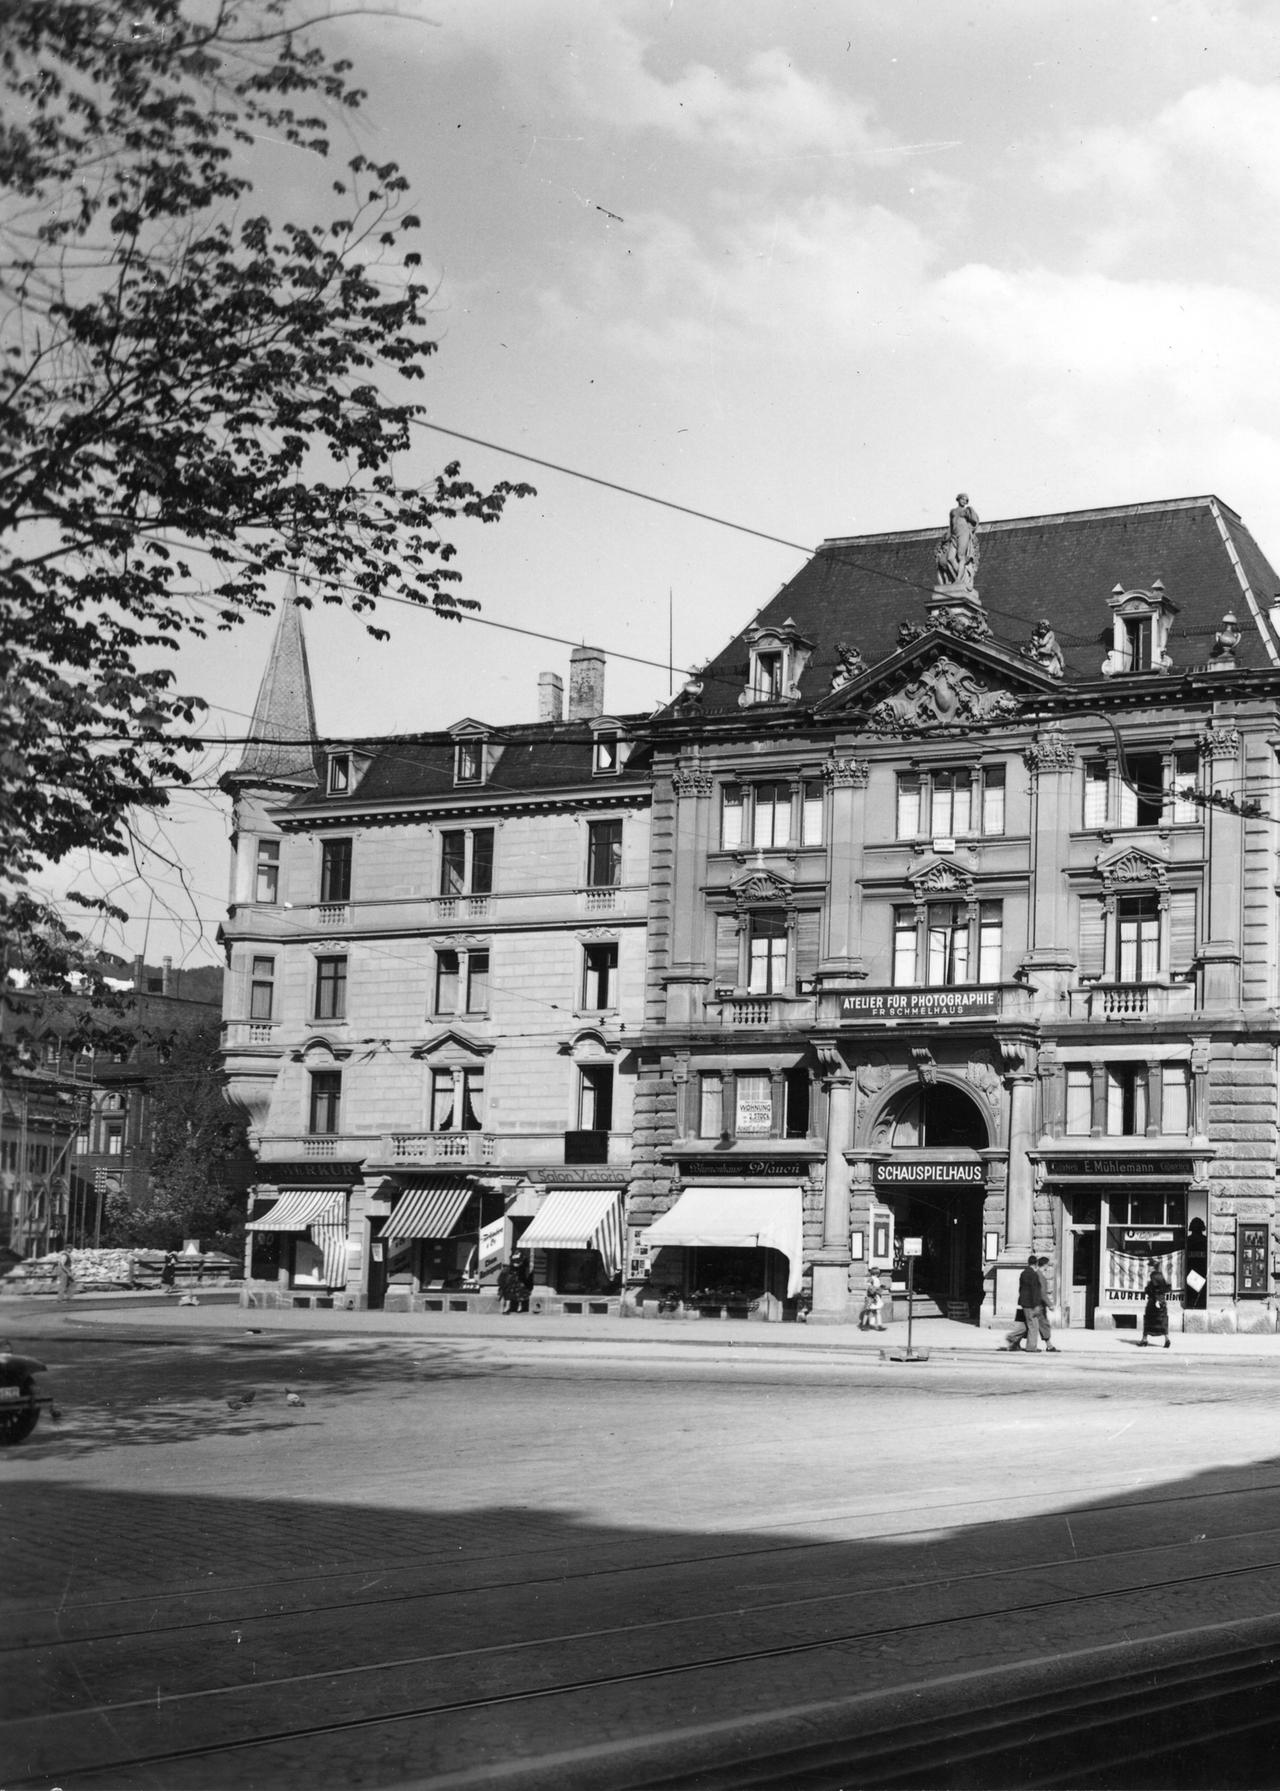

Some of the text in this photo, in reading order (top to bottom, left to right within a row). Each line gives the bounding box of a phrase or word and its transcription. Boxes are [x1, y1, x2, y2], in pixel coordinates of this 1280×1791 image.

[843, 992, 995, 1010] ATELIER FÜR PHOTOGRAPHIE
[890, 1006, 964, 1016] SCHMELHAUS
[740, 1104, 771, 1112] WOHNUNG
[281, 1163, 355, 1177] MERKUR
[1094, 1160, 1154, 1173] Mühlemann
[538, 1168, 573, 1182] Salon
[878, 1166, 982, 1181] SCHAUSPIELHAUS
[1109, 1291, 1149, 1301] LAUREN
